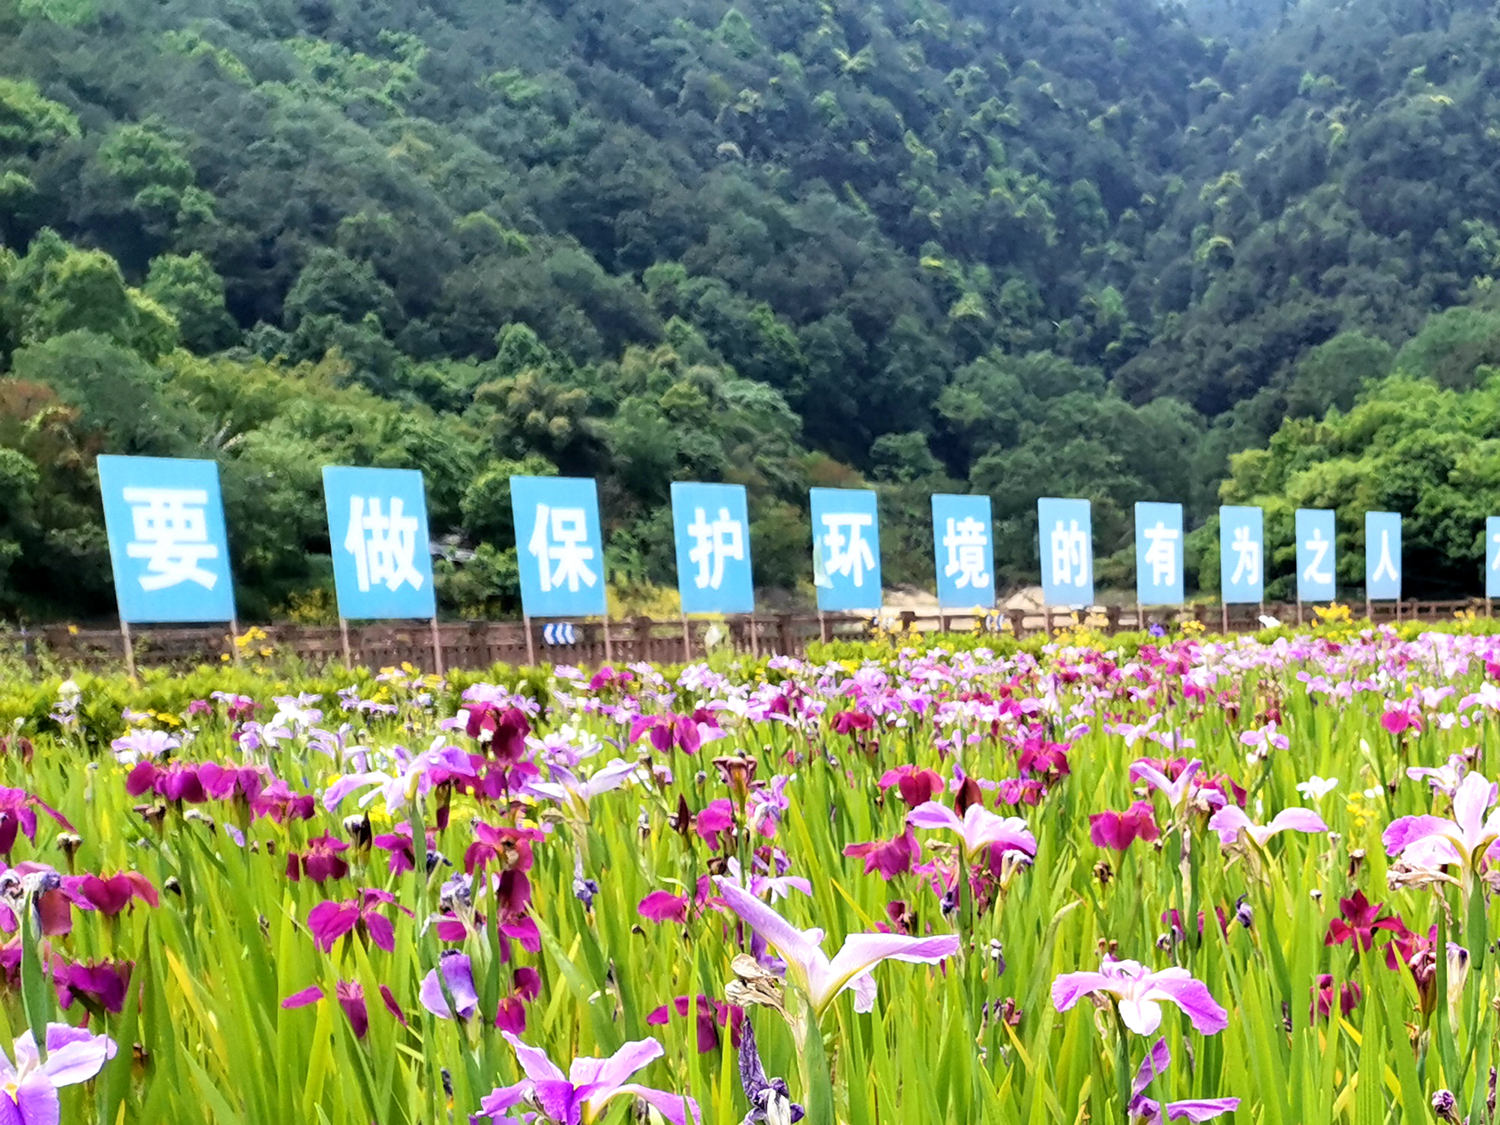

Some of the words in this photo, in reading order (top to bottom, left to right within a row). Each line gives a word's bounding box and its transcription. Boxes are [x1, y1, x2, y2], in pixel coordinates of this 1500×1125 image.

[123, 487, 218, 591] 要
[345, 496, 424, 591] 做
[529, 504, 596, 592] 保
[688, 508, 744, 590] 护
[824, 513, 875, 588] 环
[943, 517, 989, 588] 境
[1051, 520, 1087, 587] 的
[1144, 522, 1179, 586] 有
[1231, 526, 1260, 586] 为
[1303, 528, 1333, 584] 之
[1373, 530, 1399, 581] 人
